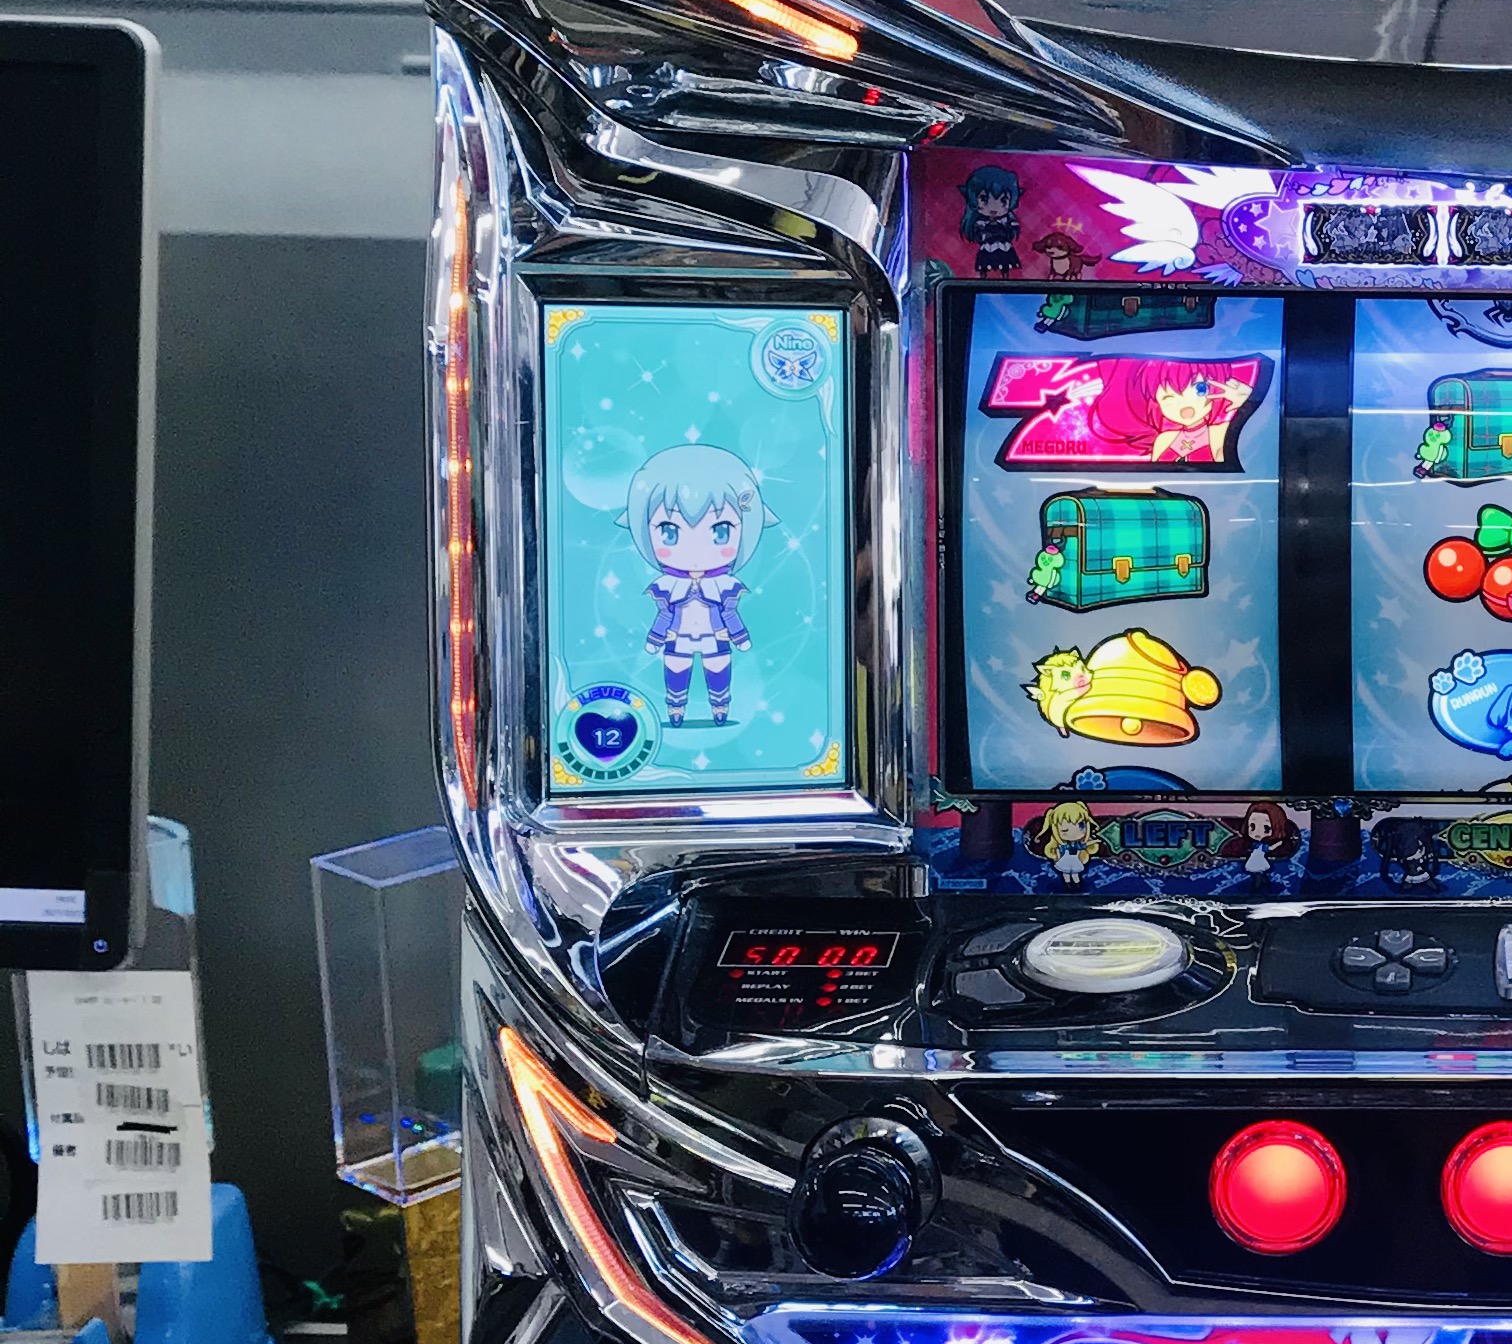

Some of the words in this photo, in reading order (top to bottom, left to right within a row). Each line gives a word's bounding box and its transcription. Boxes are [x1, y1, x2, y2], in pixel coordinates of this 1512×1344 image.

[577, 689, 632, 708] LEVEL
[594, 728, 622, 747] 12
[1123, 820, 1213, 848] LEFT
